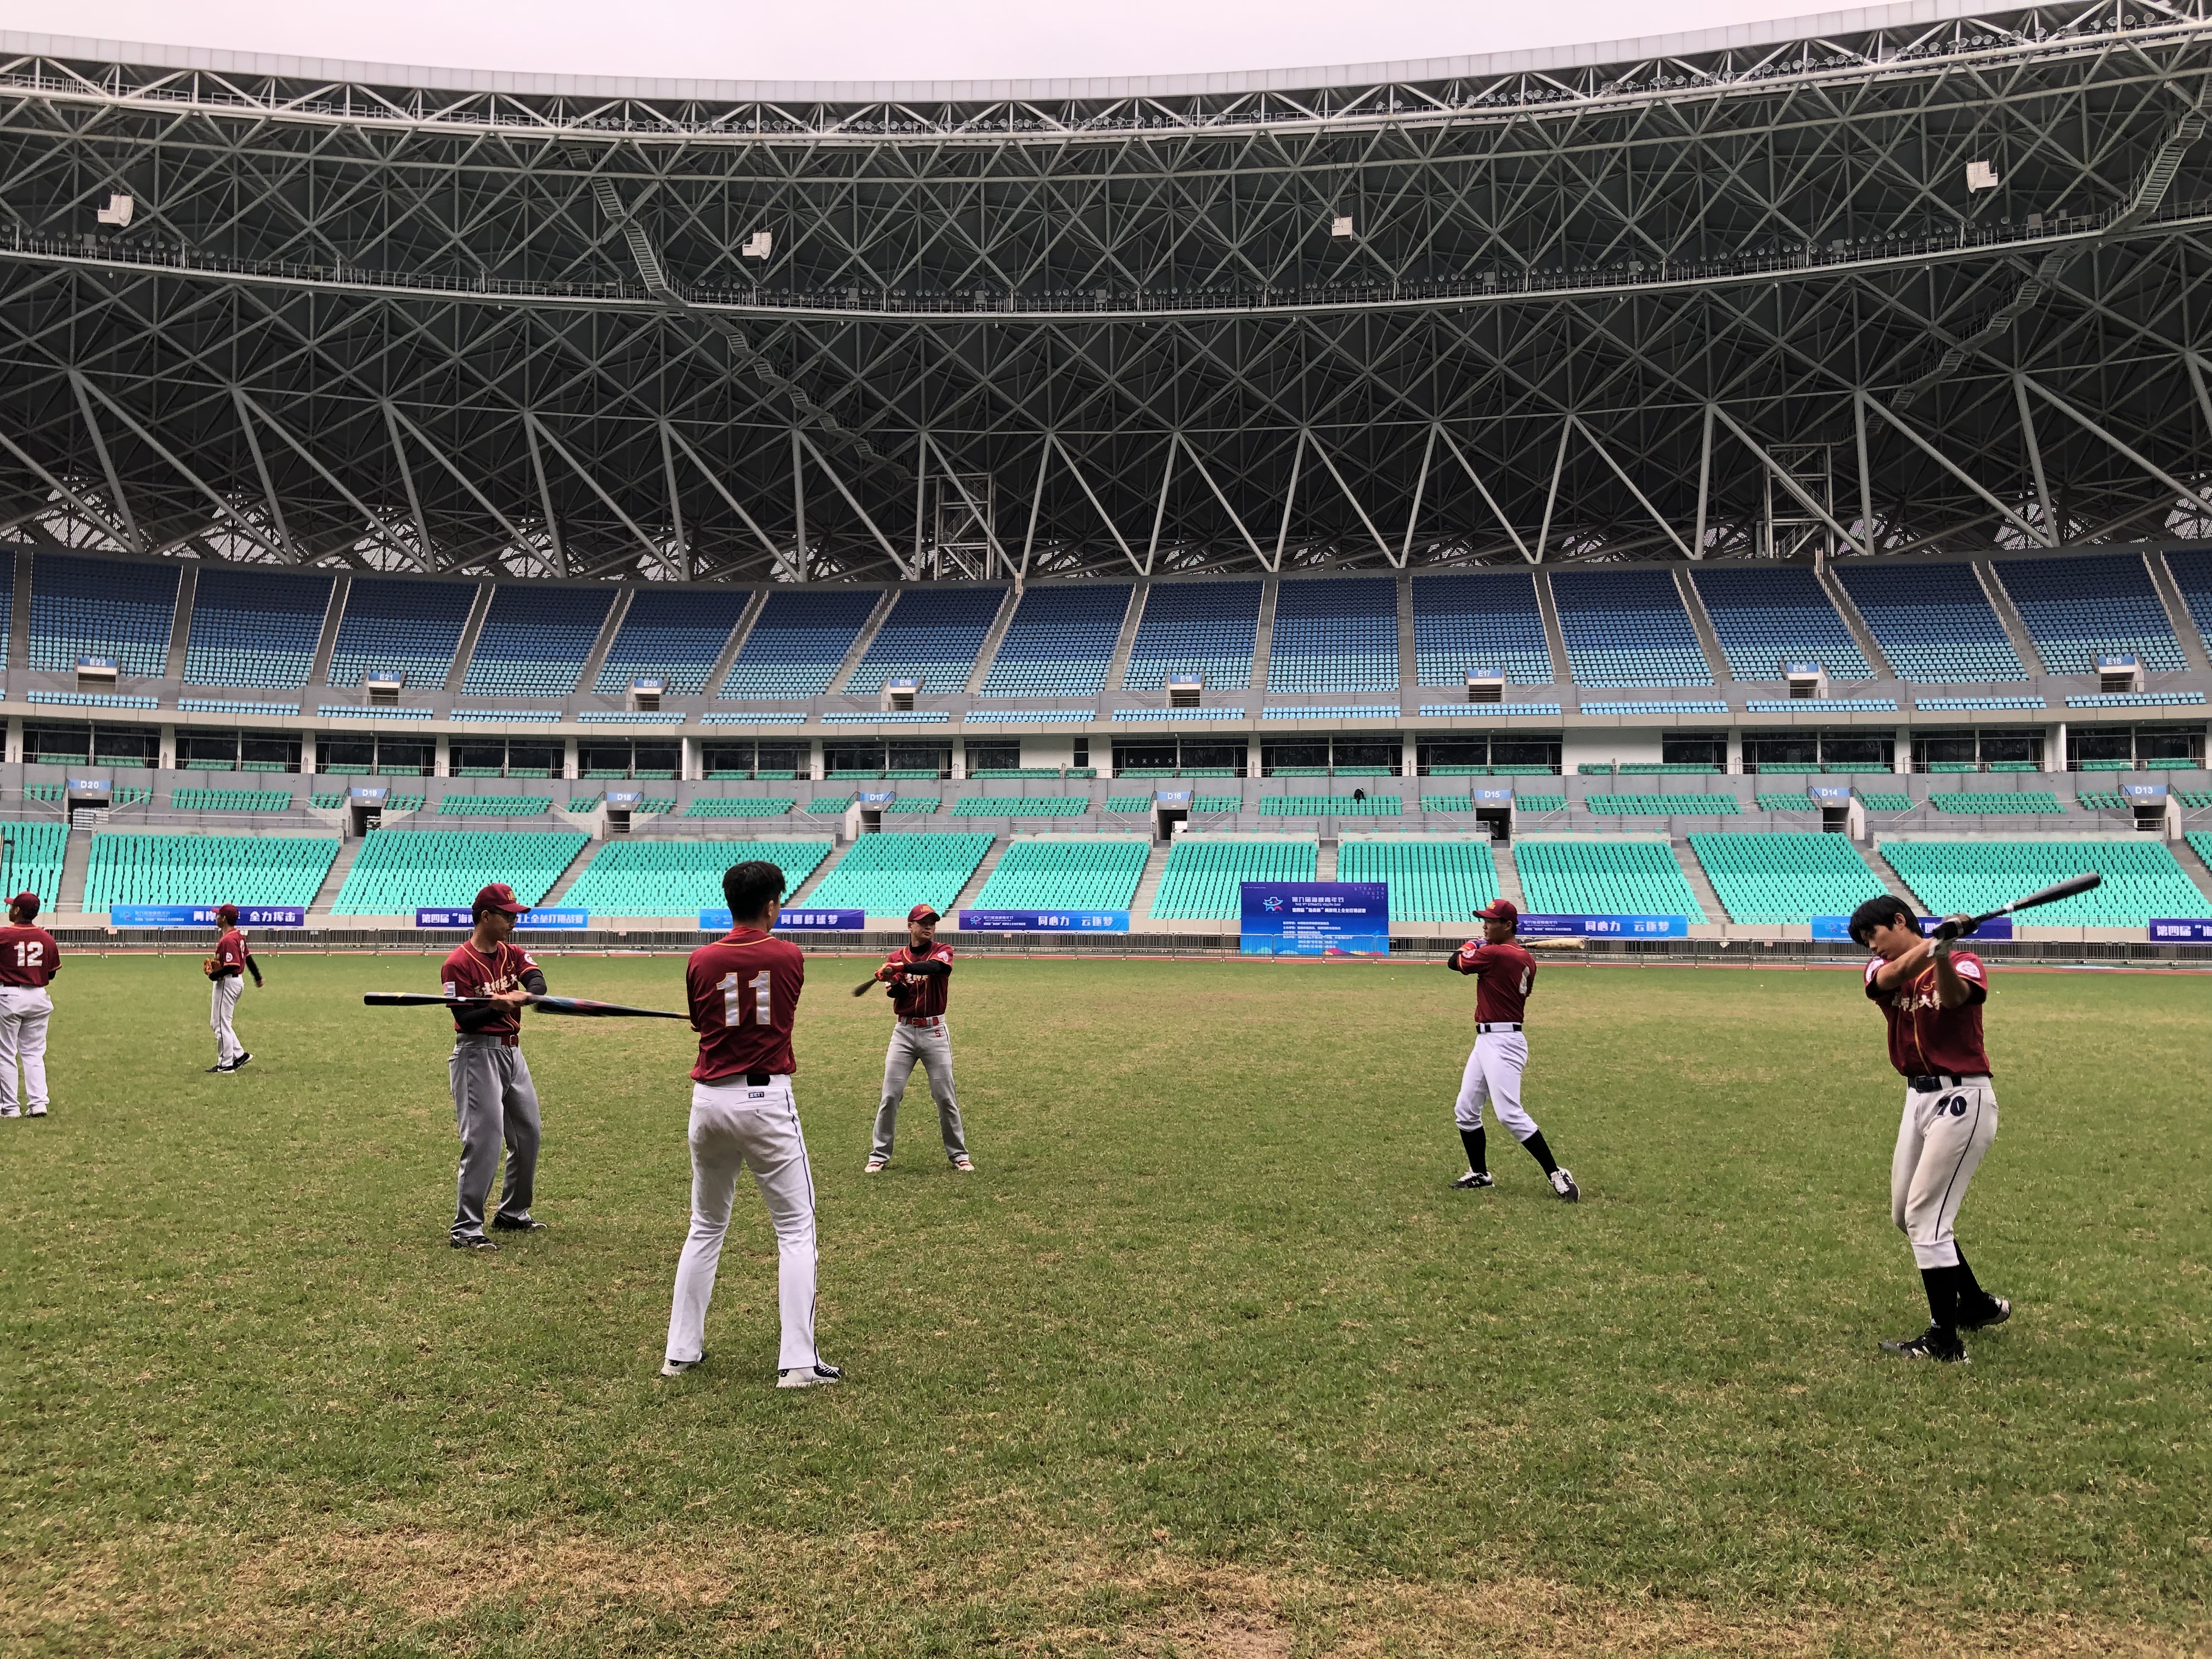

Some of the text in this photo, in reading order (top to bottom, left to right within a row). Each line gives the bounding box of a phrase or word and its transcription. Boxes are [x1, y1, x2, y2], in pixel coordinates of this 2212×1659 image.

[80, 780, 99, 789] D20
[2135, 786, 2153, 794] D13
[249, 910, 296, 922] 全力挥击
[1038, 916, 1069, 927] 同心力
[1585, 920, 1621, 932] 同心力
[14, 941, 43, 967] 12
[716, 970, 771, 1026] 11
